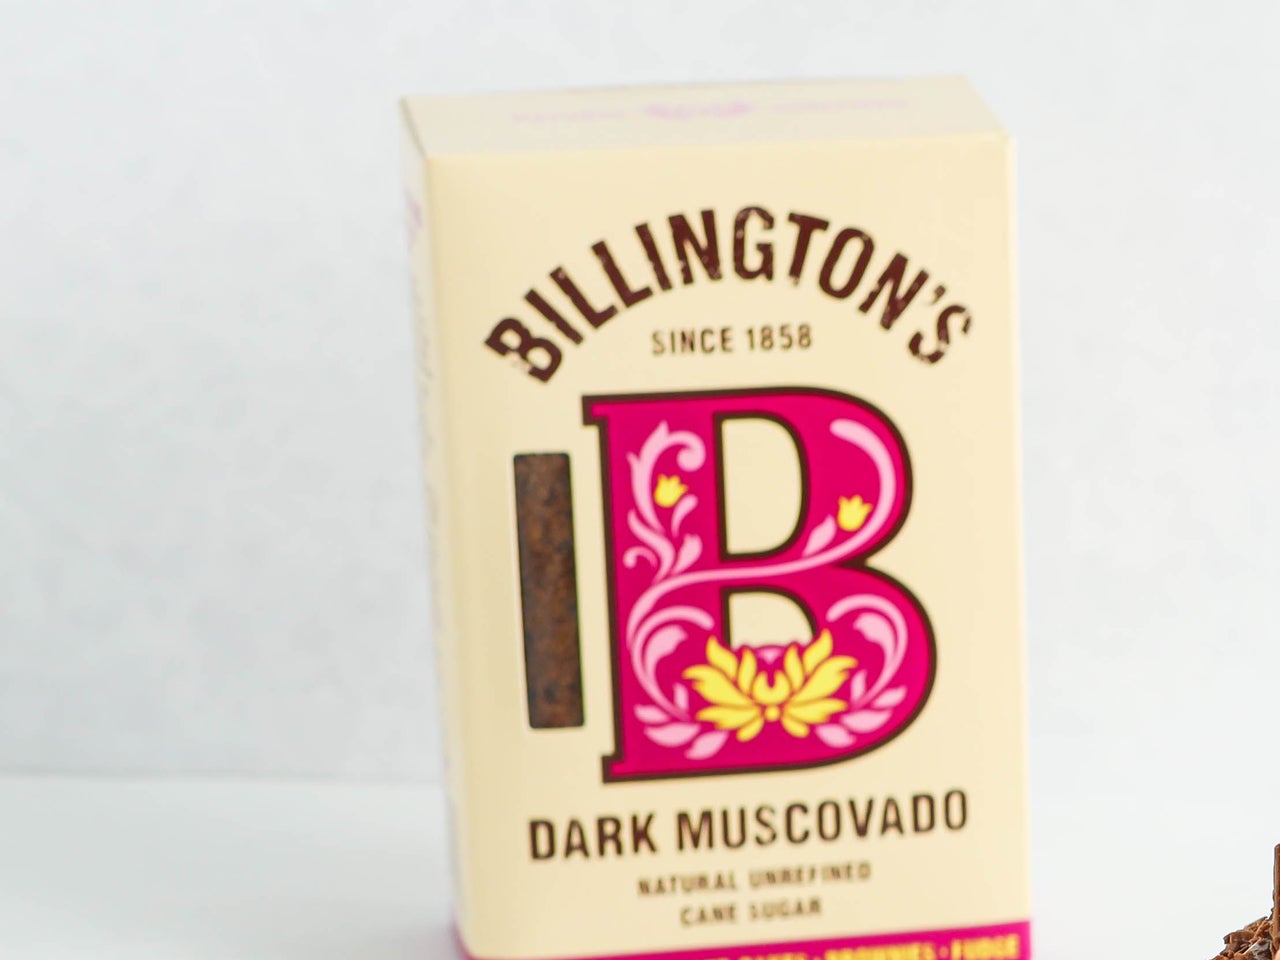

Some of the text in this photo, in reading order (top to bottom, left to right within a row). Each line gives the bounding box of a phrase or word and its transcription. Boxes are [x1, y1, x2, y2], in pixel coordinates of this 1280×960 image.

[483, 206, 972, 384] BILLINGTON'S
[651, 323, 814, 356] SINCE 1858
[581, 386, 938, 784] B
[528, 789, 970, 862] DARK MUSCOVADO
[637, 860, 872, 898] NATURAL UNREFINED
[680, 897, 822, 928] CANE SUGAR
